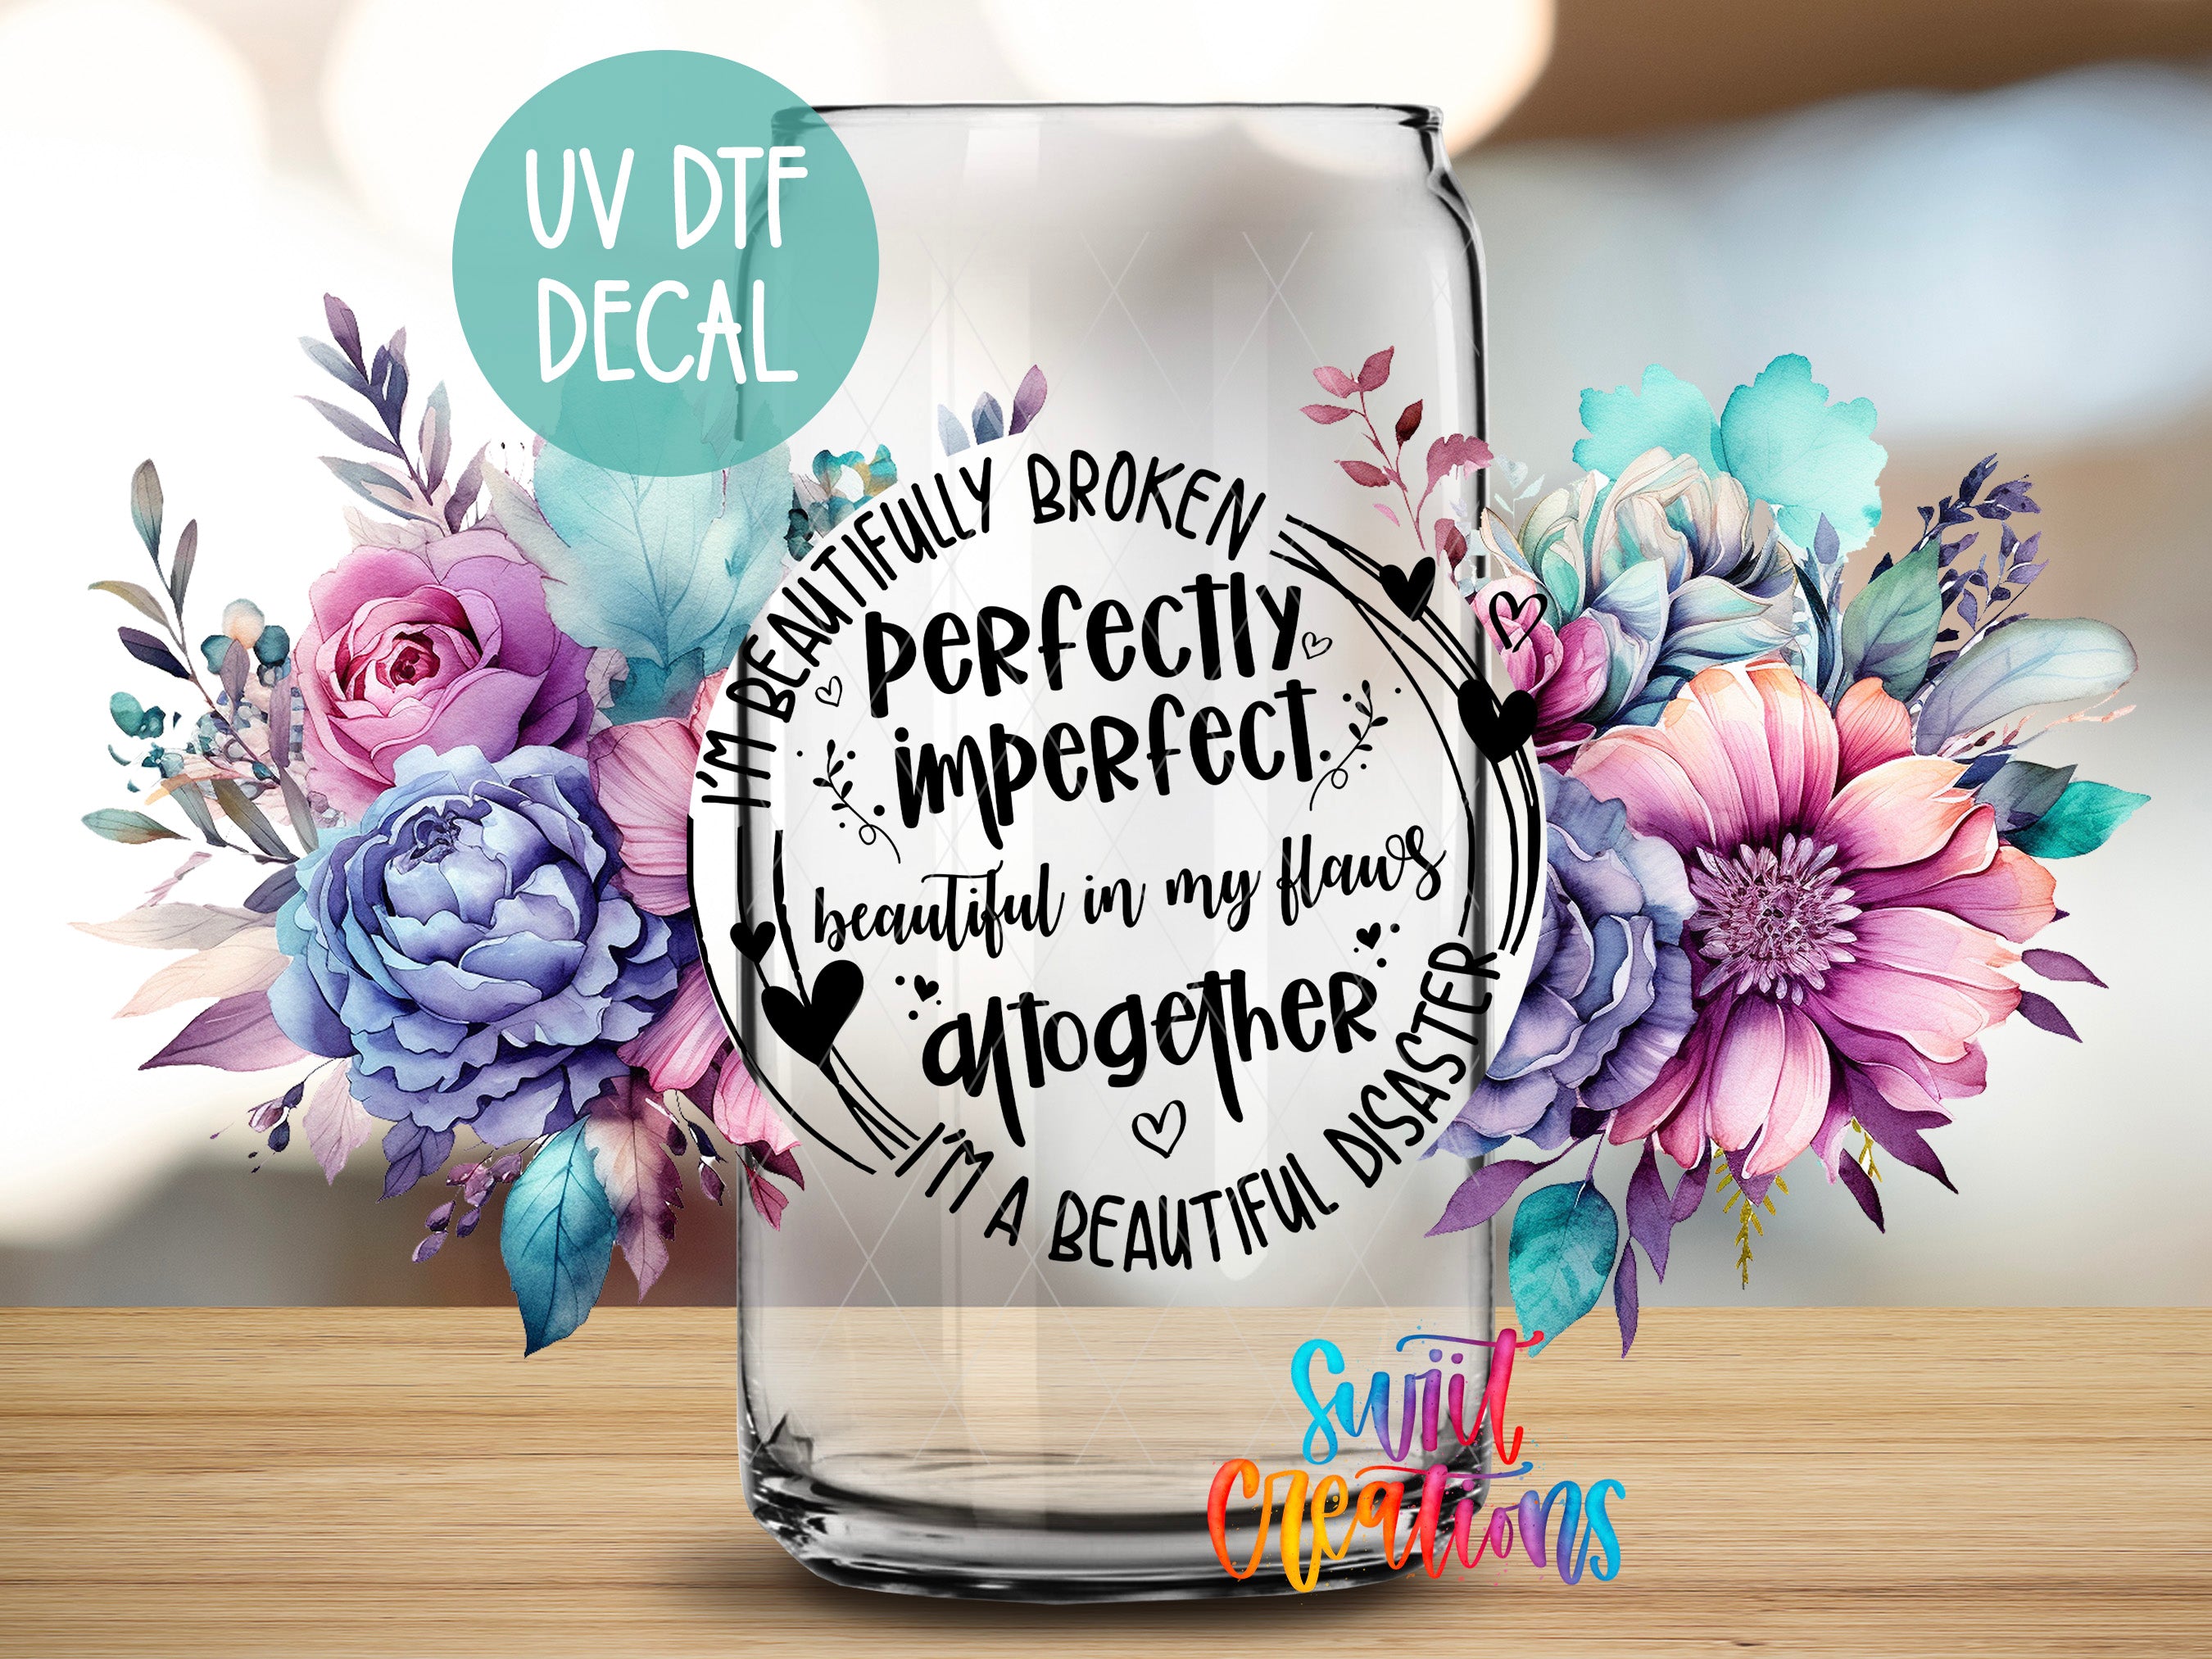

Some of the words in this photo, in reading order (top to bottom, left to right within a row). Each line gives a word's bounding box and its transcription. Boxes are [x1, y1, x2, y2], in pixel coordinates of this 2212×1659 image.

[1027, 450, 1266, 560] BROKEN
[725, 456, 991, 723] BEAUTIFULLY
[696, 730, 777, 808] I'M
[814, 860, 1065, 959] beautiful
[1083, 875, 1146, 927] in
[1166, 868, 1261, 932] my
[1276, 825, 1447, 926] flaws
[895, 1122, 994, 1214] I'M
[984, 1176, 1029, 1247] A
[1048, 1153, 1339, 1272] BEAUTIFUL
[1323, 941, 1501, 1188] DISASTER
